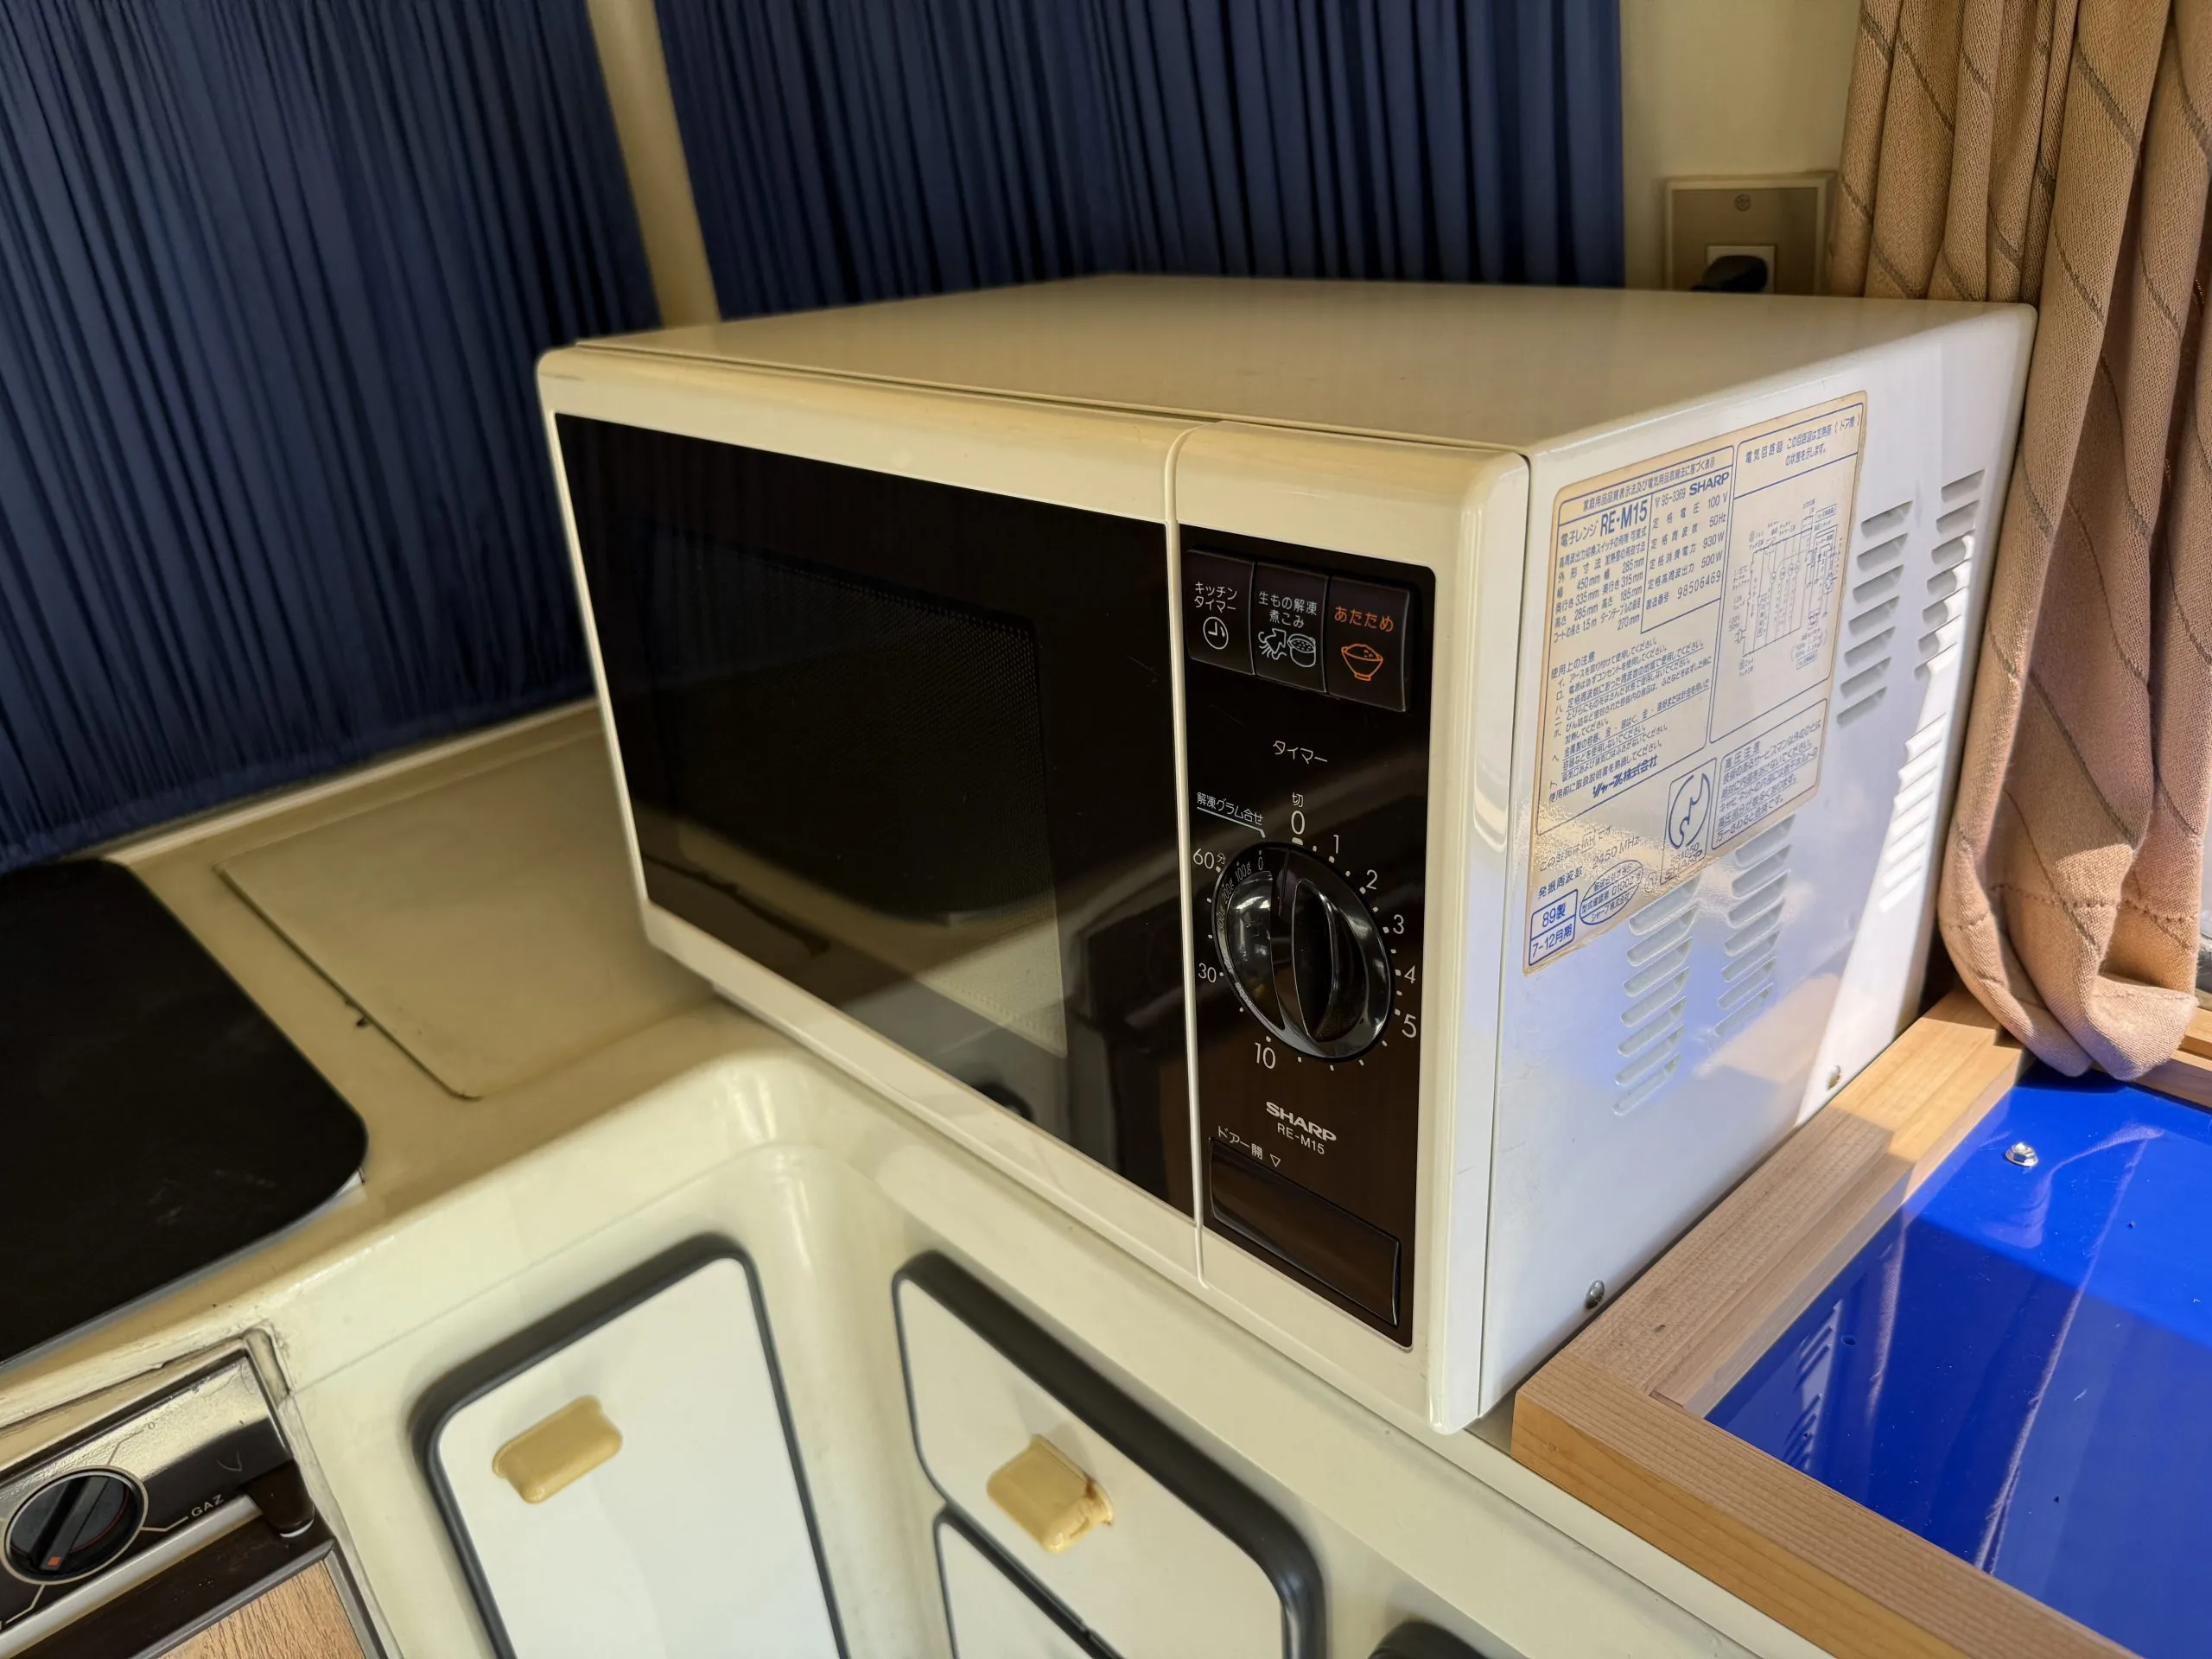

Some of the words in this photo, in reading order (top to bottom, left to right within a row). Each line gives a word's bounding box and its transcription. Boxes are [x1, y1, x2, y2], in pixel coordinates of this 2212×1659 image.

[1745, 440, 1783, 464] 電気回路図
[1689, 471, 1729, 496] SHARP
[1560, 518, 1598, 548] 電子レンジ
[1194, 581, 1237, 601] キッチン
[1646, 591, 1668, 610] 製造番号
[1677, 569, 1720, 599] 98506469
[1194, 596, 1236, 613] タイマー
[1258, 590, 1318, 616] 生もの解凍
[1269, 609, 1305, 629] 煮こみ
[1334, 606, 1394, 632] あたため
[1551, 650, 1595, 679] 使用上の注意
[1273, 740, 1328, 765] タイマー
[1592, 753, 1657, 798] シャープ株式会社
[1197, 791, 1263, 826] 解凍グラム合せ
[1292, 791, 1304, 808] 切
[1291, 810, 1306, 836] 0
[1333, 834, 1339, 854] 1
[1366, 869, 1378, 890] 2
[1392, 914, 1405, 935] 3
[1541, 900, 1565, 929] 89製
[1198, 963, 1217, 983] 30
[1404, 965, 1417, 984] 4
[1402, 1014, 1418, 1038] 5
[1254, 1042, 1277, 1070] 10
[1266, 1101, 1338, 1142] SHARP
[1217, 1125, 1263, 1160] ドアー開
[1277, 1122, 1325, 1155] RE-M15
[191, 1493, 225, 1518] GAZ
